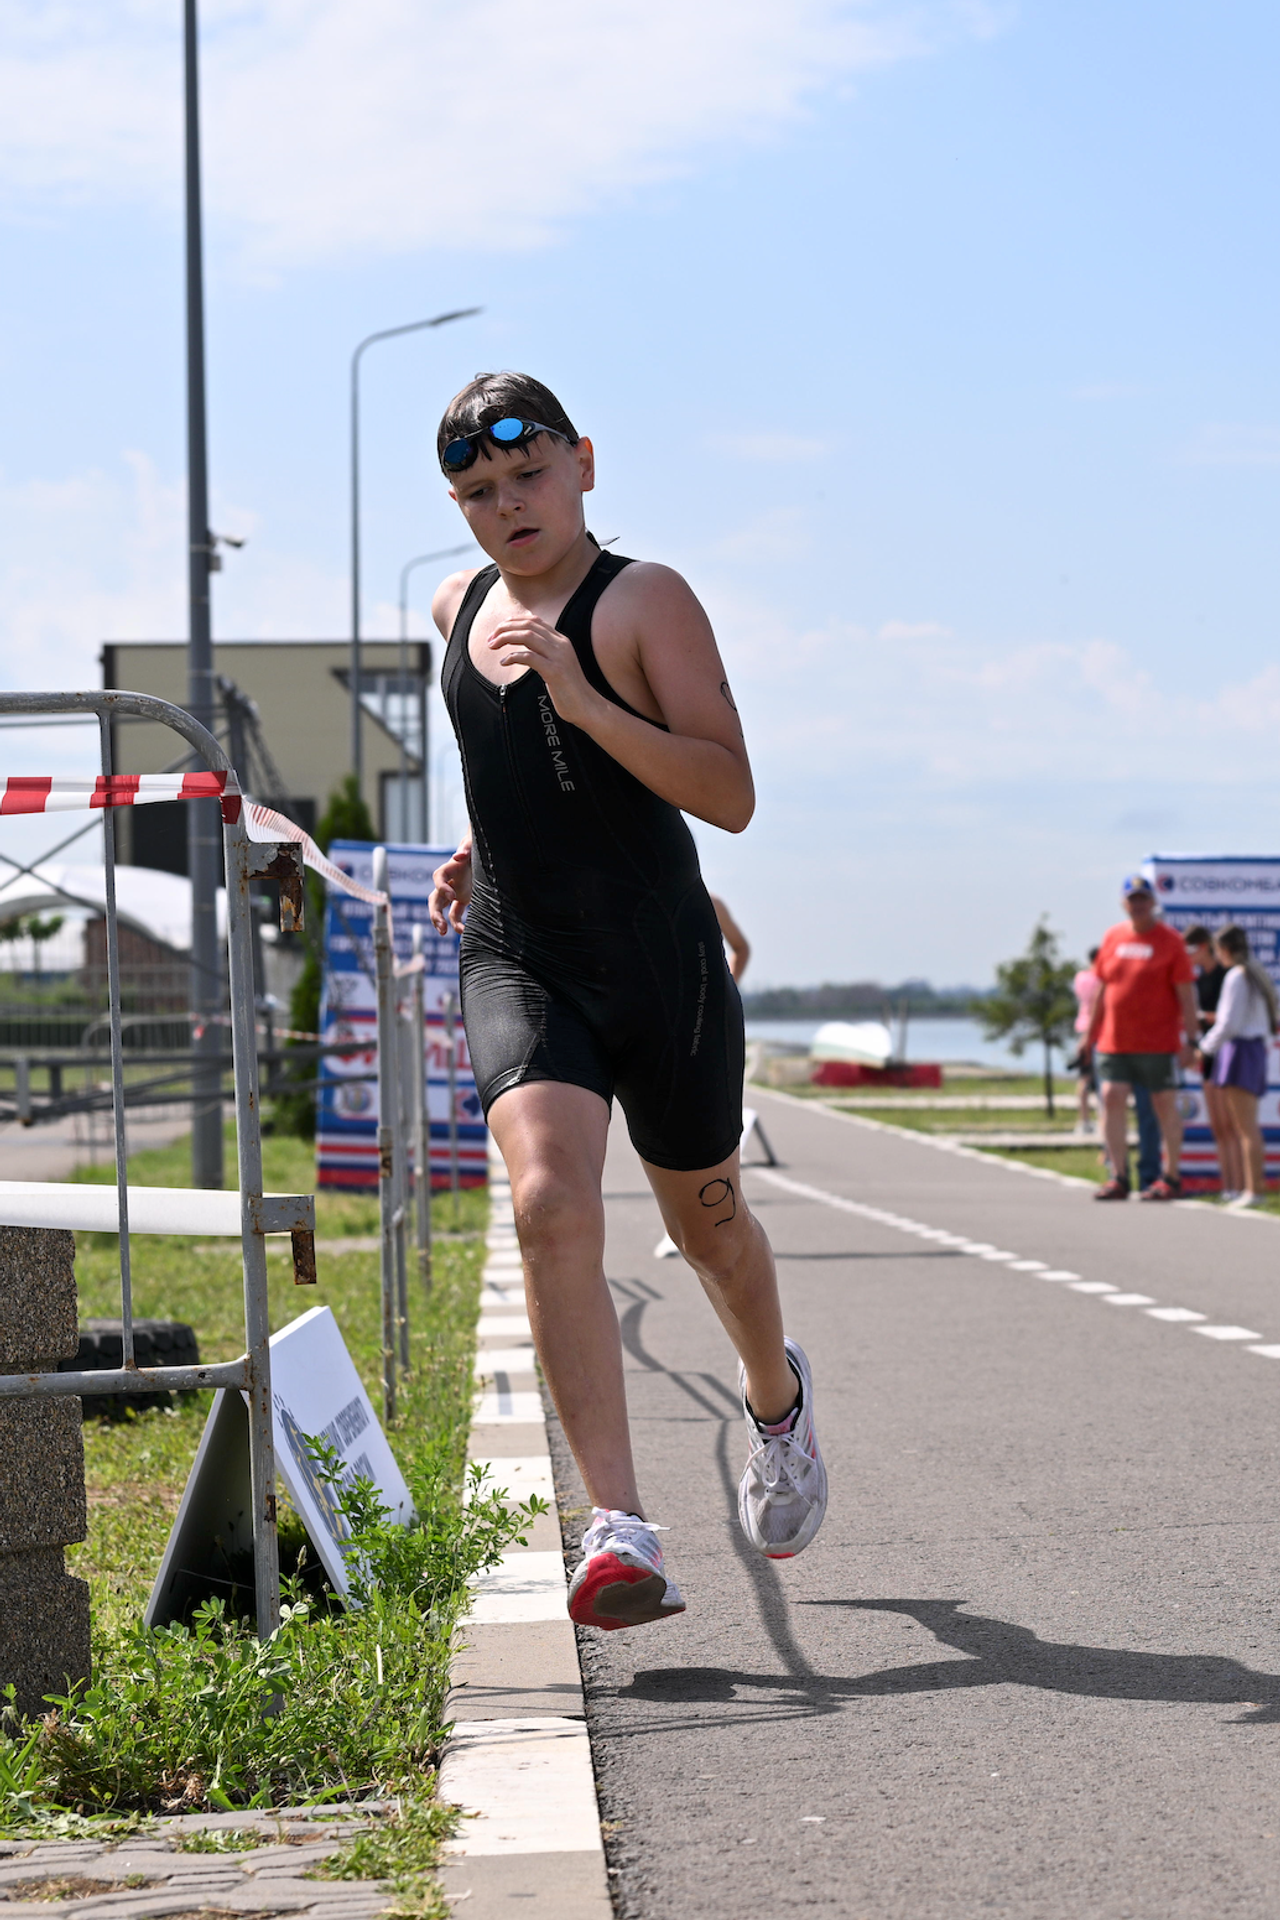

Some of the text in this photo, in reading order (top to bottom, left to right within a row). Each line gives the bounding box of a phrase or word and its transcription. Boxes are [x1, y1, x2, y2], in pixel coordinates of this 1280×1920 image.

[537, 694, 576, 792] MORE MILE
[698, 941, 706, 957] stay
[700, 958, 709, 975] cool
[697, 984, 708, 1004] body
[693, 1005, 704, 1034] cooling
[690, 1035, 701, 1057] fabric
[698, 1177, 736, 1228] 9
